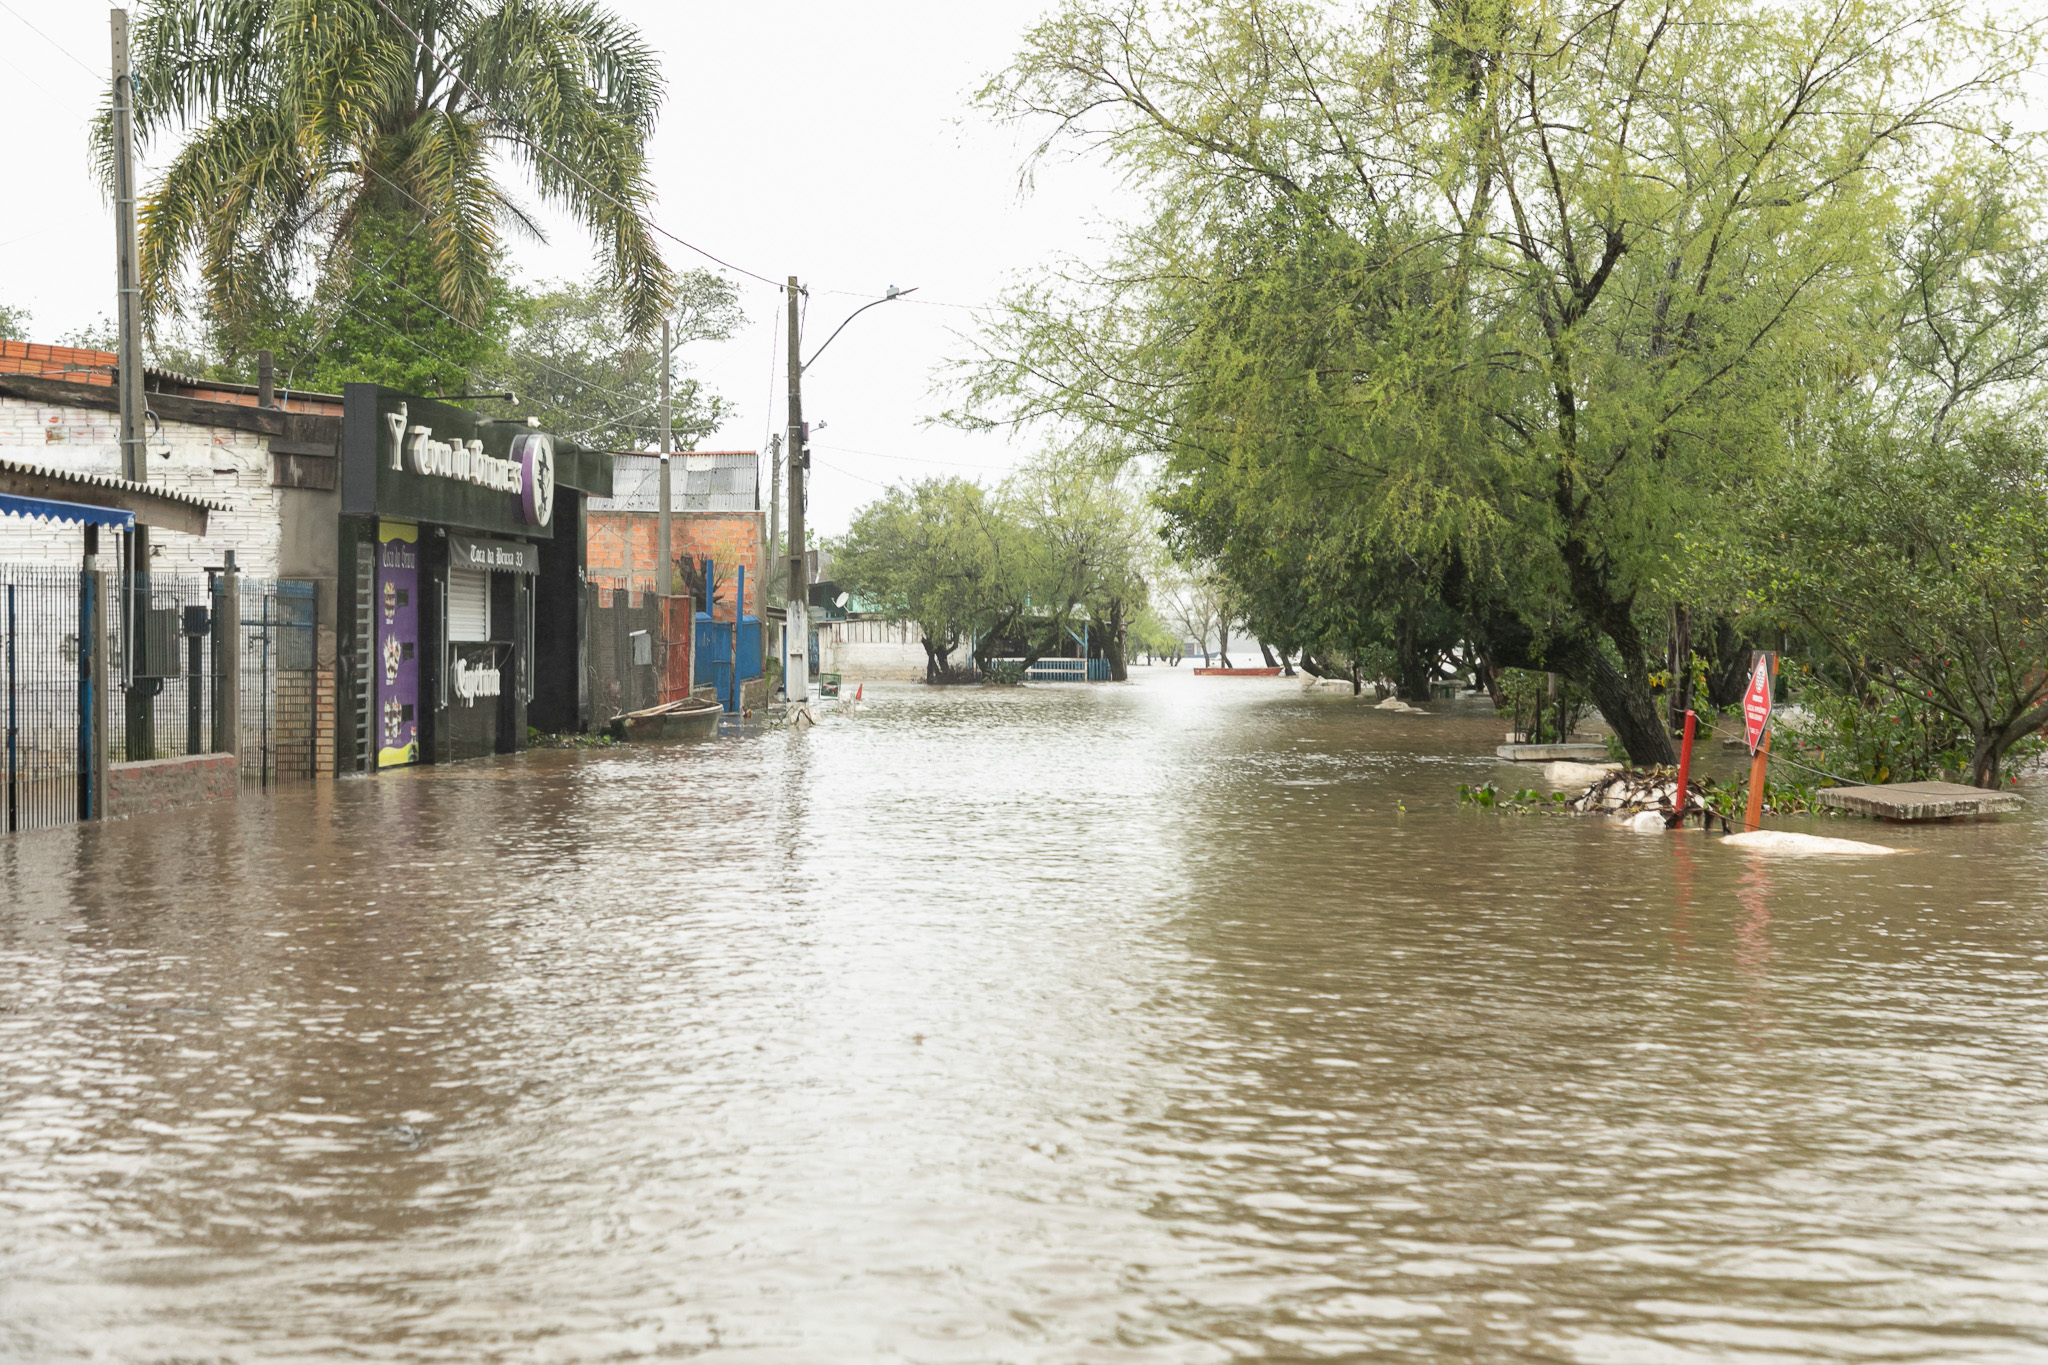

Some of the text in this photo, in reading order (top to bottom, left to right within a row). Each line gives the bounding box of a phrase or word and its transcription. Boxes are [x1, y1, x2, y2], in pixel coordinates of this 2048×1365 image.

[470, 544, 523, 567] Toca da Bruxa 33
